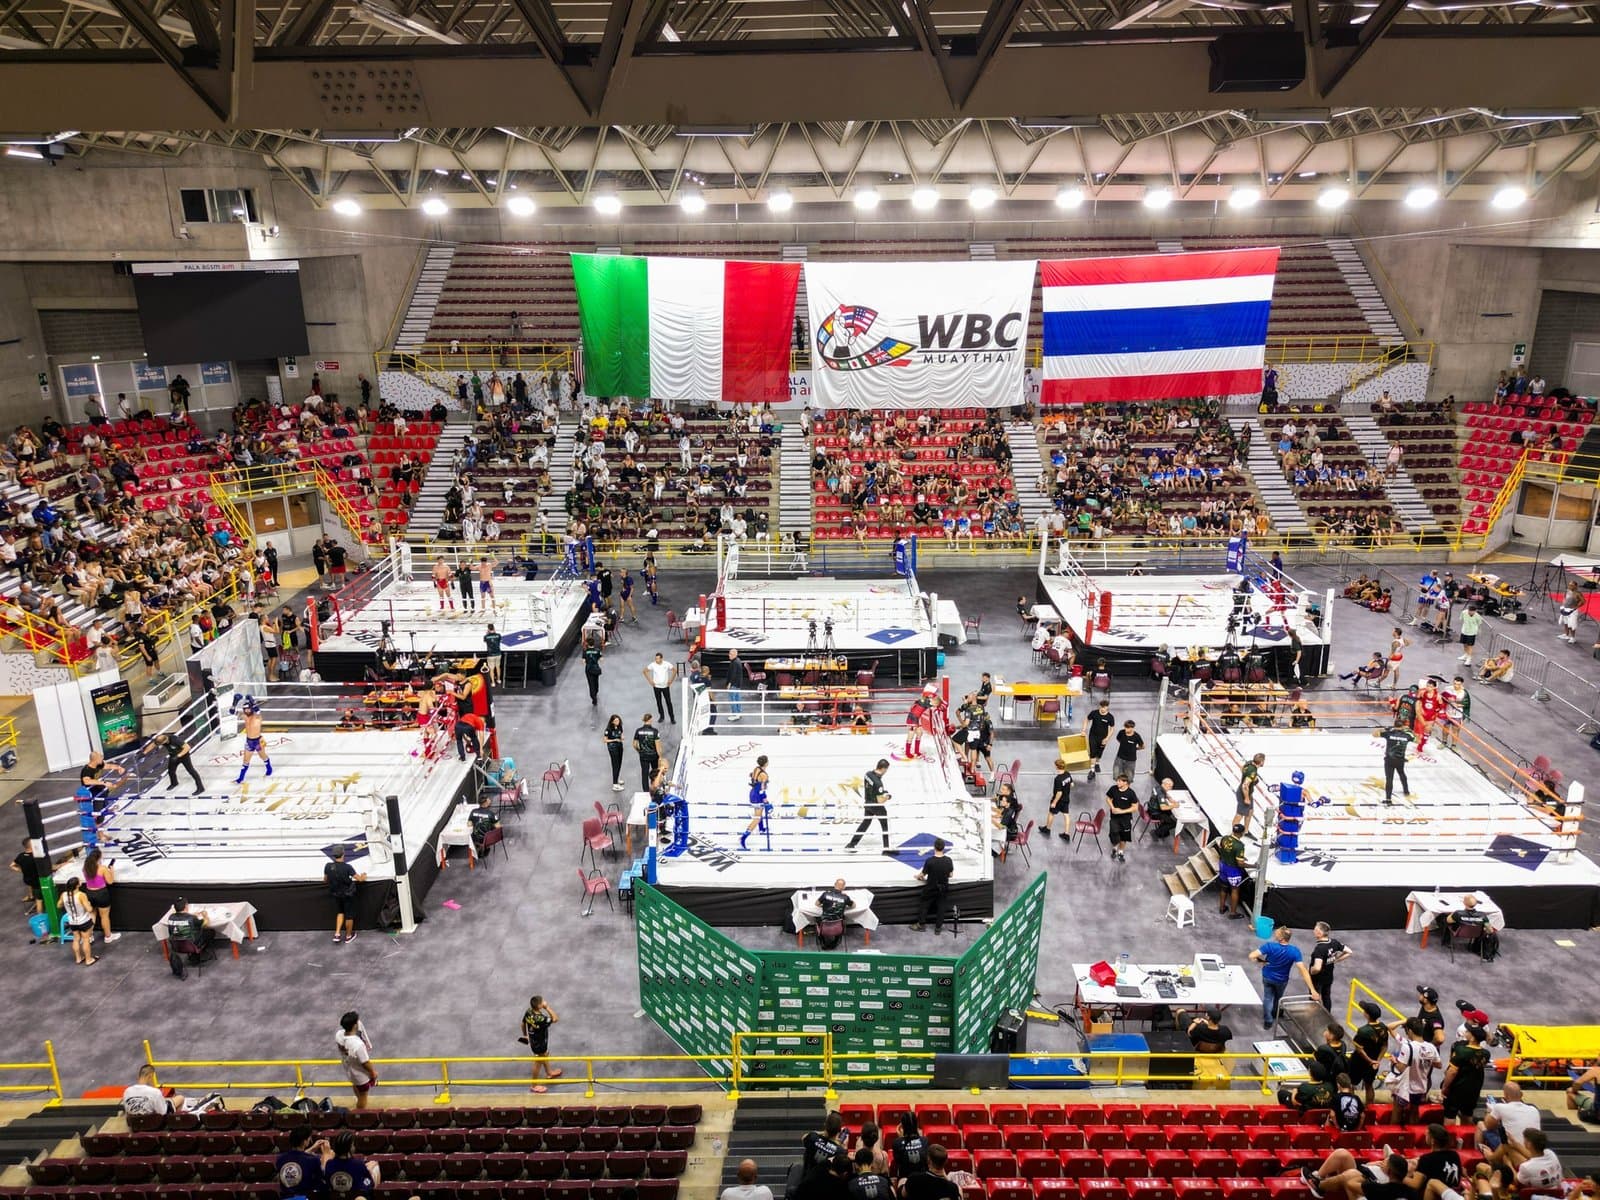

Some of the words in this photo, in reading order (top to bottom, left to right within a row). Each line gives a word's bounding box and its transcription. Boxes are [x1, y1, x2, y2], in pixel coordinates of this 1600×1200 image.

[917, 312, 1022, 349] WBC
[923, 353, 1011, 364] MUAYTHAI
[698, 740, 762, 768] THACCA
[281, 812, 331, 821] 2025
[1381, 817, 1429, 826] 2025
